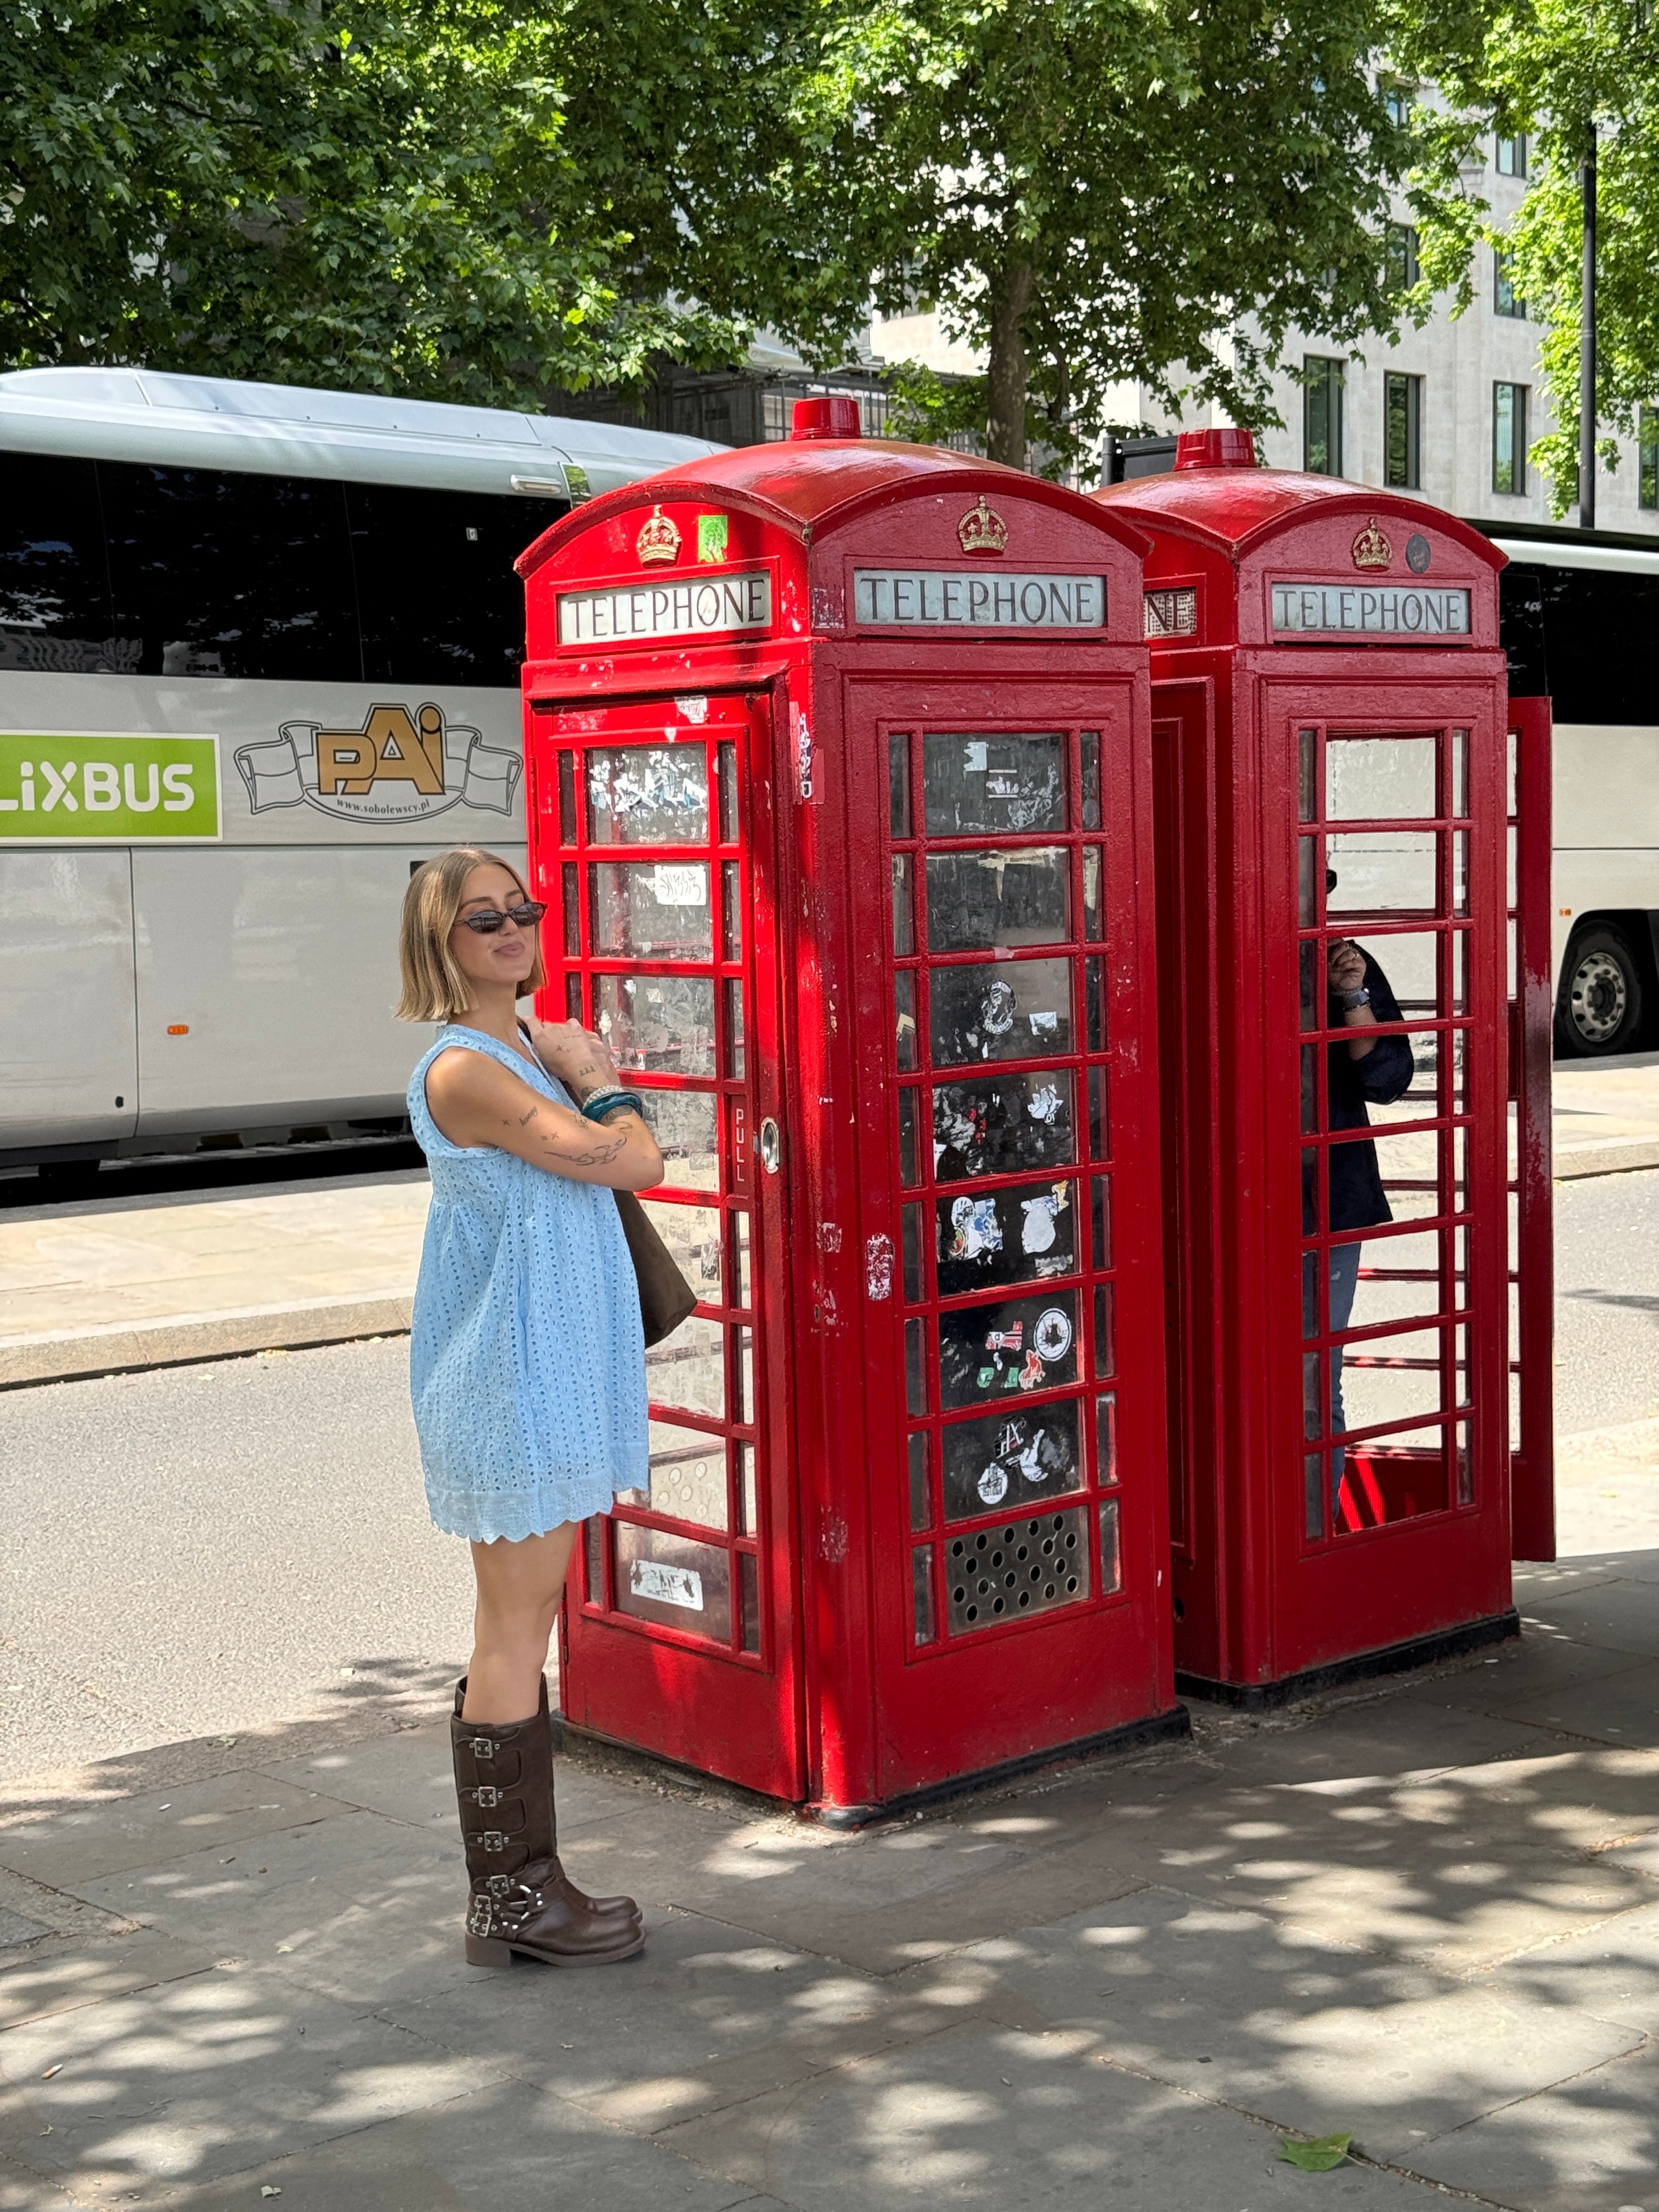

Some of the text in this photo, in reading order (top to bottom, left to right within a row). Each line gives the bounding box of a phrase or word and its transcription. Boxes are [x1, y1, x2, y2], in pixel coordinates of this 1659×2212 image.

[568, 579, 765, 639] TELEPHONE
[860, 578, 1094, 624] TELEPHONE
[1147, 592, 1190, 633] NE
[1275, 590, 1460, 631] TELEPHONE
[336, 798, 430, 814] www.sobolewscy.pl
[736, 1108, 745, 1182] PULL
